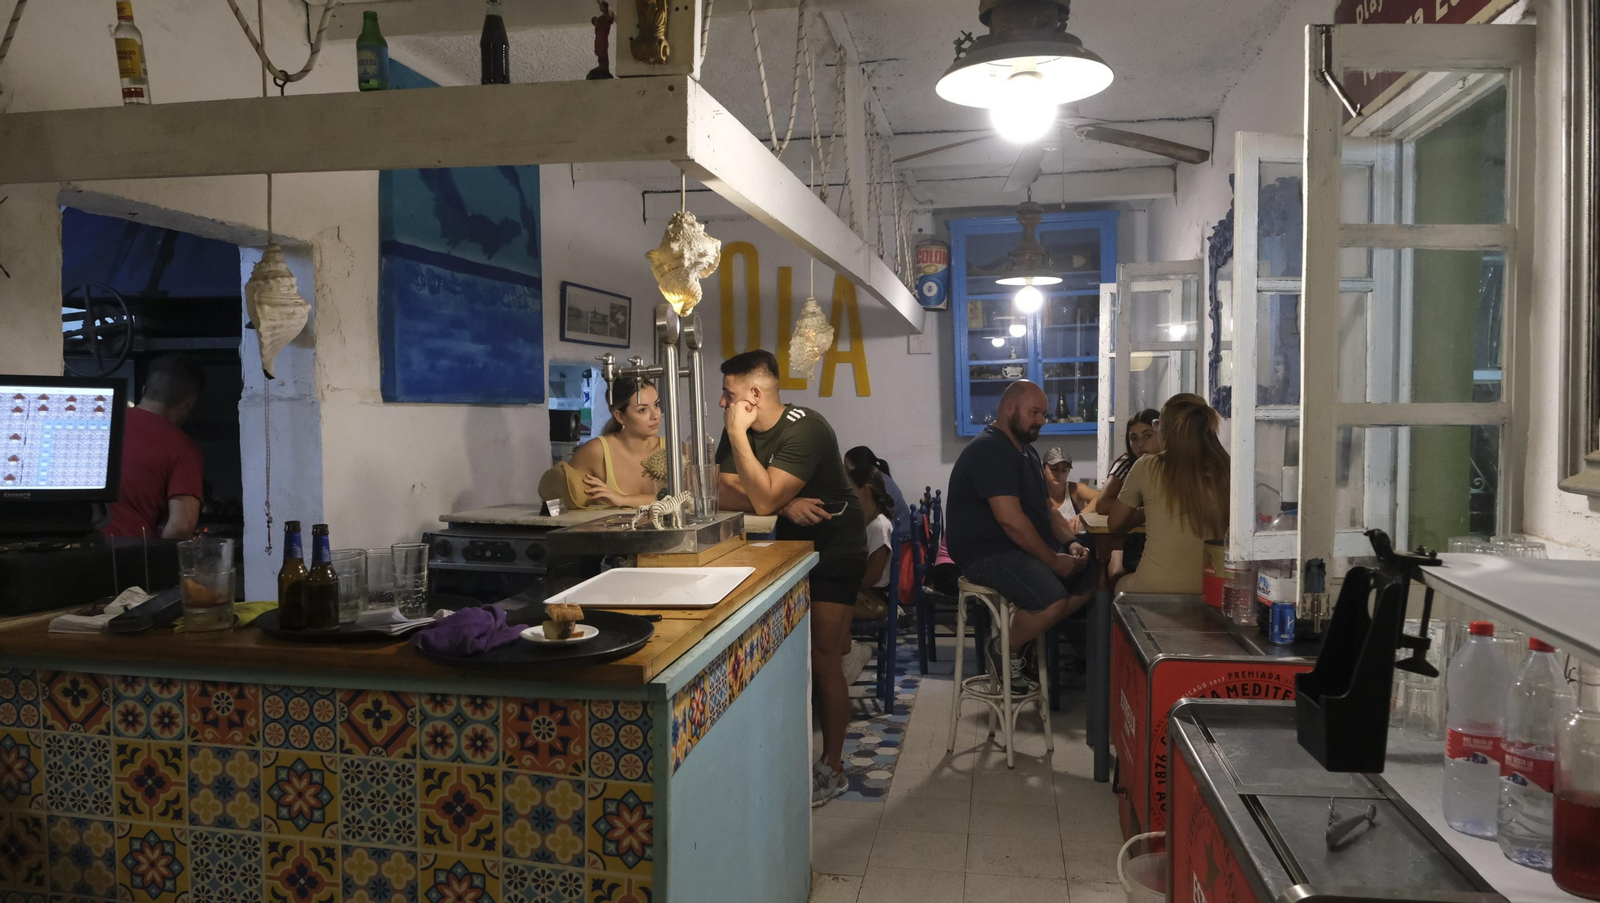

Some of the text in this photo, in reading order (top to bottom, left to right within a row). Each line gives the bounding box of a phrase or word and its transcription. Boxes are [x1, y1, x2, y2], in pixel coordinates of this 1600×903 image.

[720, 241, 871, 397] OLA
[1228, 671, 1281, 682] PREMIADA
[1226, 683, 1294, 700] MEDITE
[1155, 754, 1167, 785] 1876
